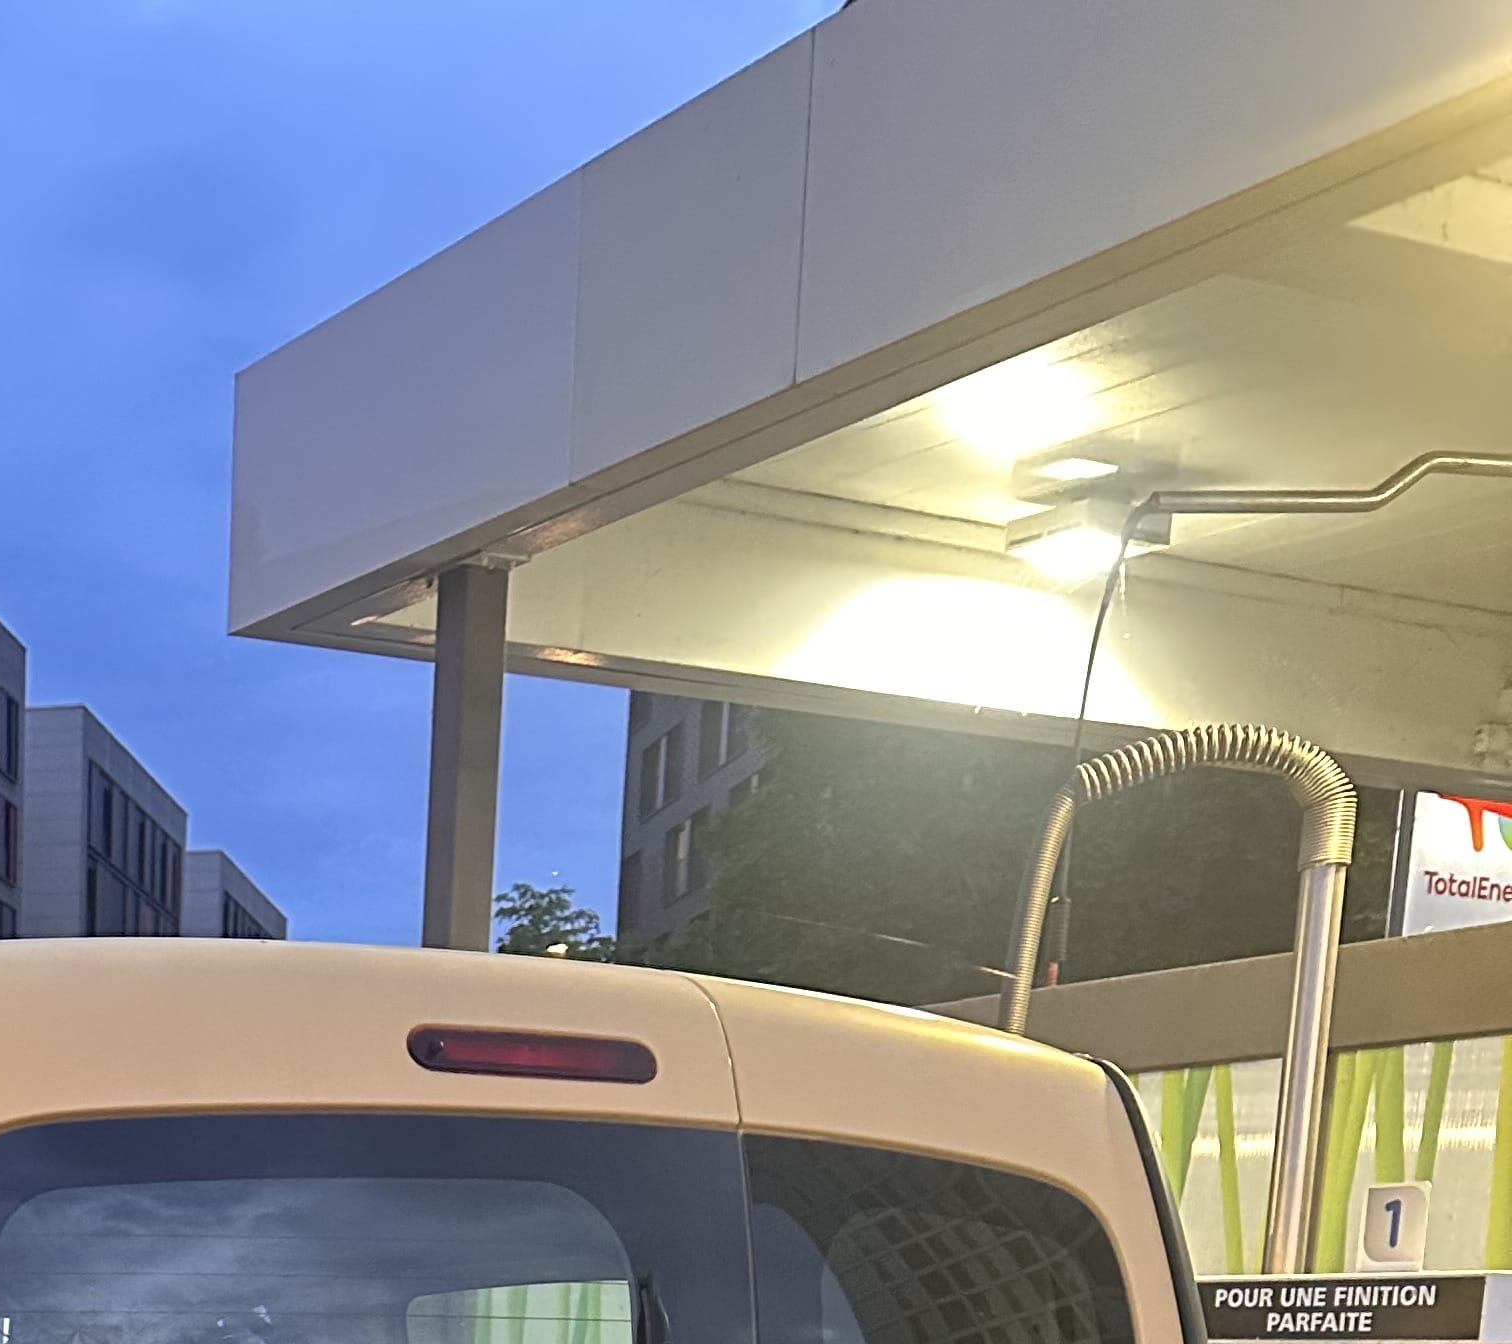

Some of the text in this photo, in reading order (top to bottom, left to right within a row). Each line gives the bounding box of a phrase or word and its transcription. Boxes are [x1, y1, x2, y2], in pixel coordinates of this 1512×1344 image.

[1385, 1199, 1402, 1249] 1
[1214, 1285, 1437, 1308] POUR UNE FINITION
[1265, 1312, 1374, 1333] PARFAITE
